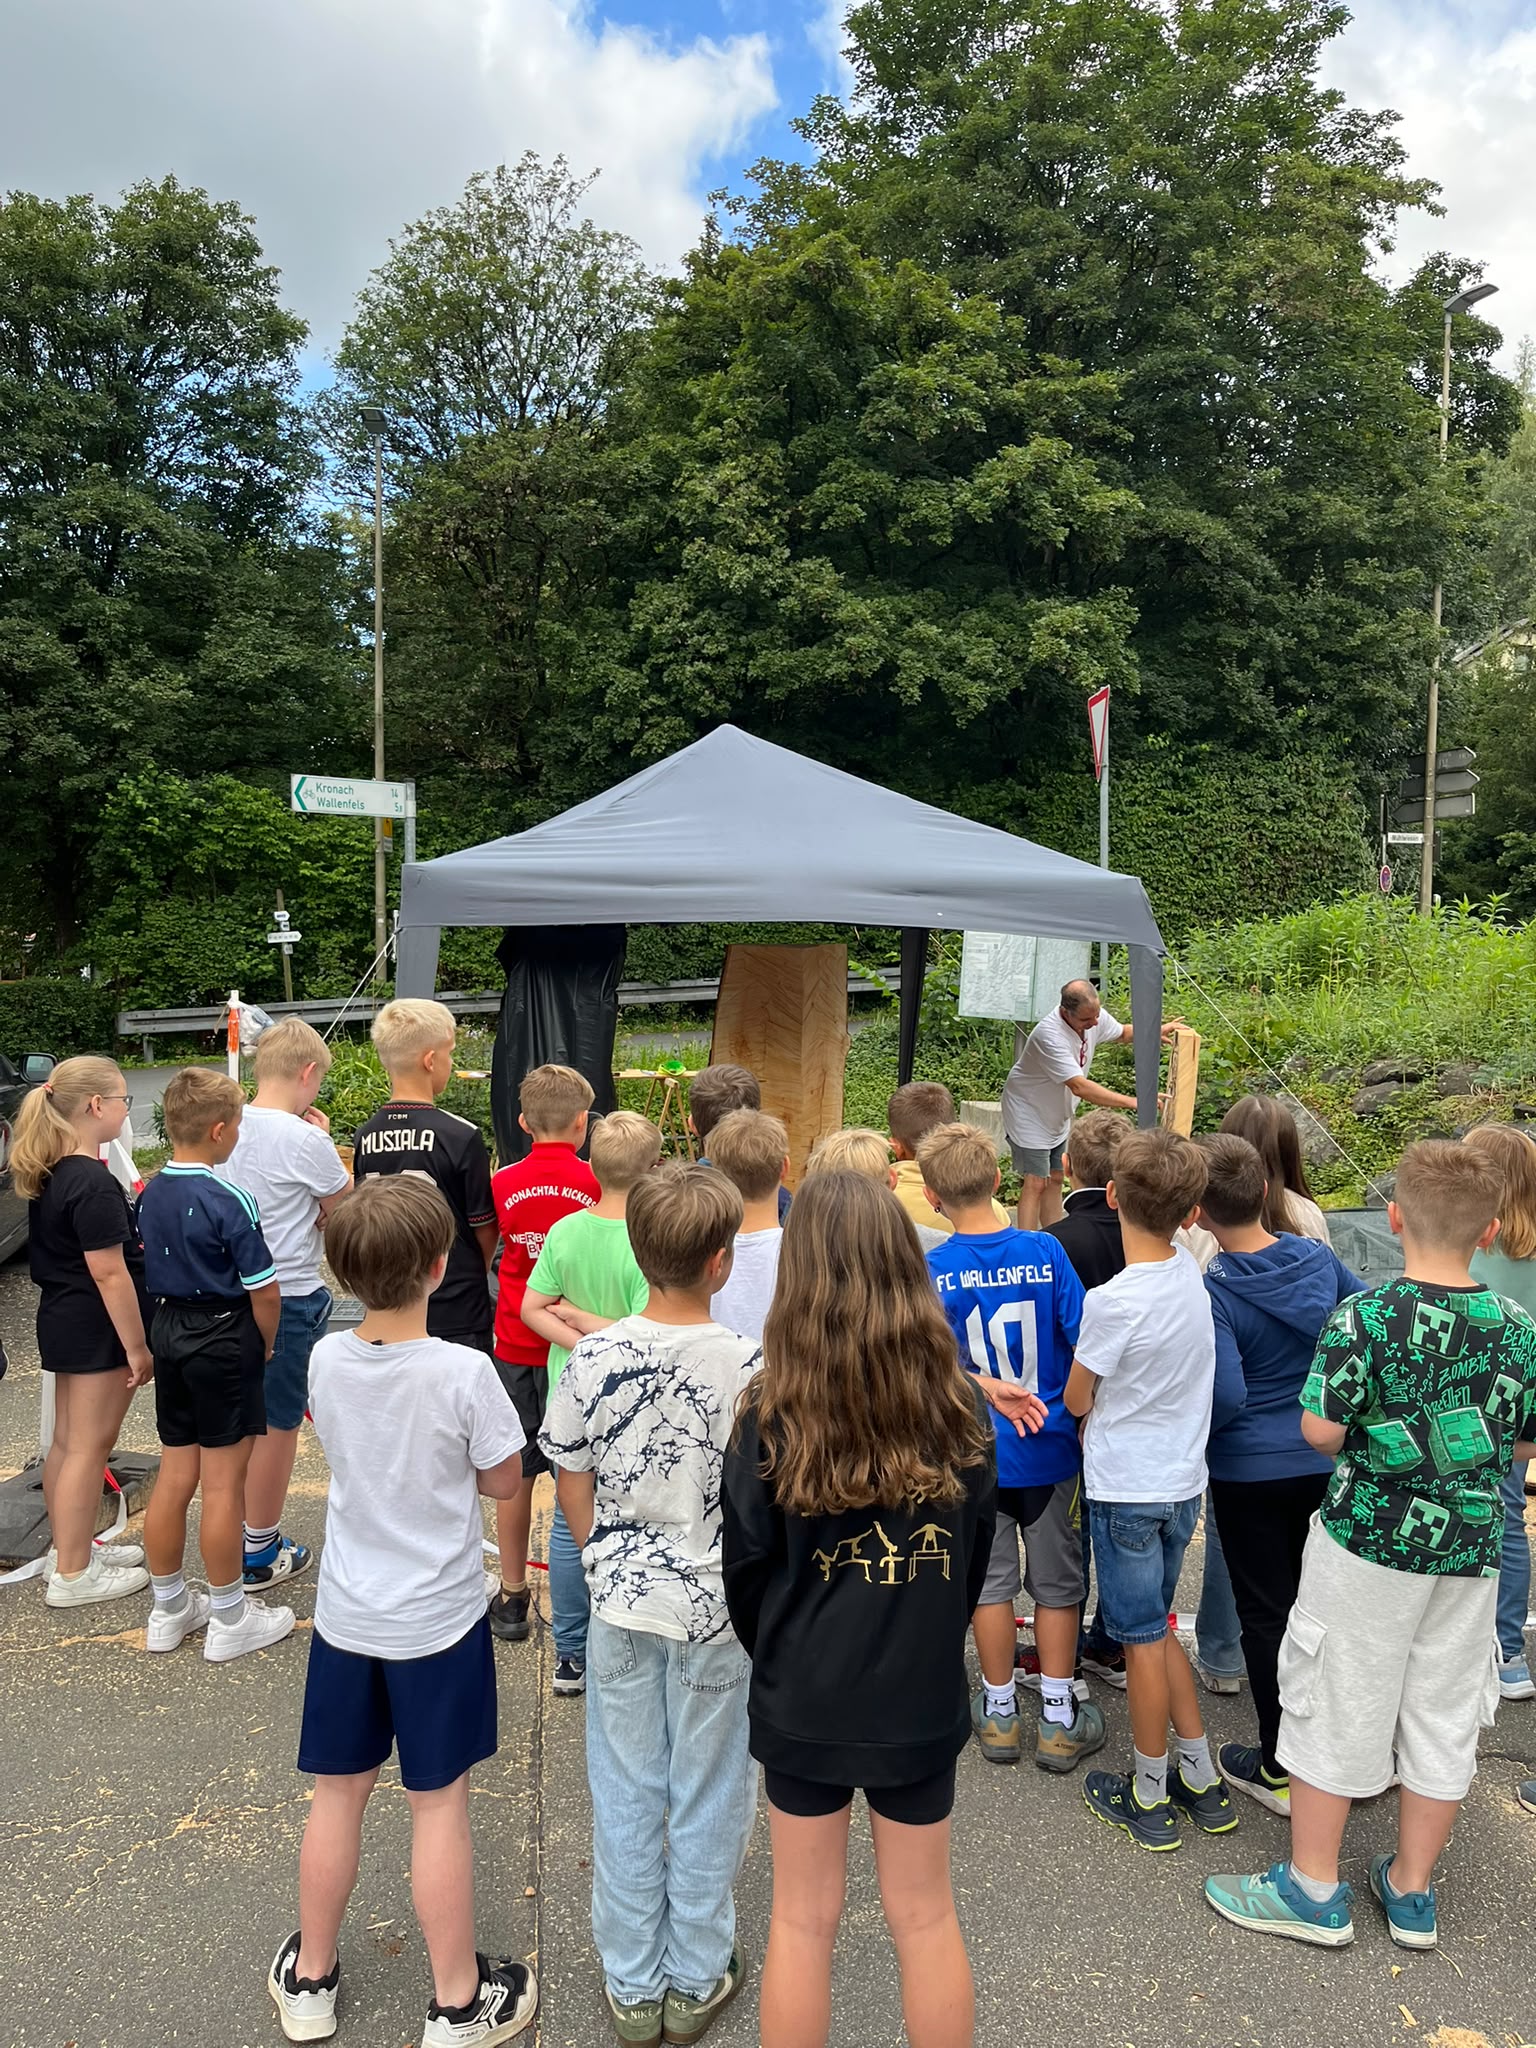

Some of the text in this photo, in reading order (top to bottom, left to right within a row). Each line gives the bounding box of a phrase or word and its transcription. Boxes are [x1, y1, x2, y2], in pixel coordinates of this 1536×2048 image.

[315, 783, 399, 798] Kronach 14
[316, 797, 365, 810] Wallenfels
[361, 1128, 435, 1156] MUSIALA
[504, 1185, 559, 1211] KRONACHTAL
[936, 1263, 1053, 1293] FC WALLENFELS
[965, 1299, 1039, 1394] 10
[1508, 1347, 1528, 1364] THE
[630, 2007, 653, 2020] NIKE
